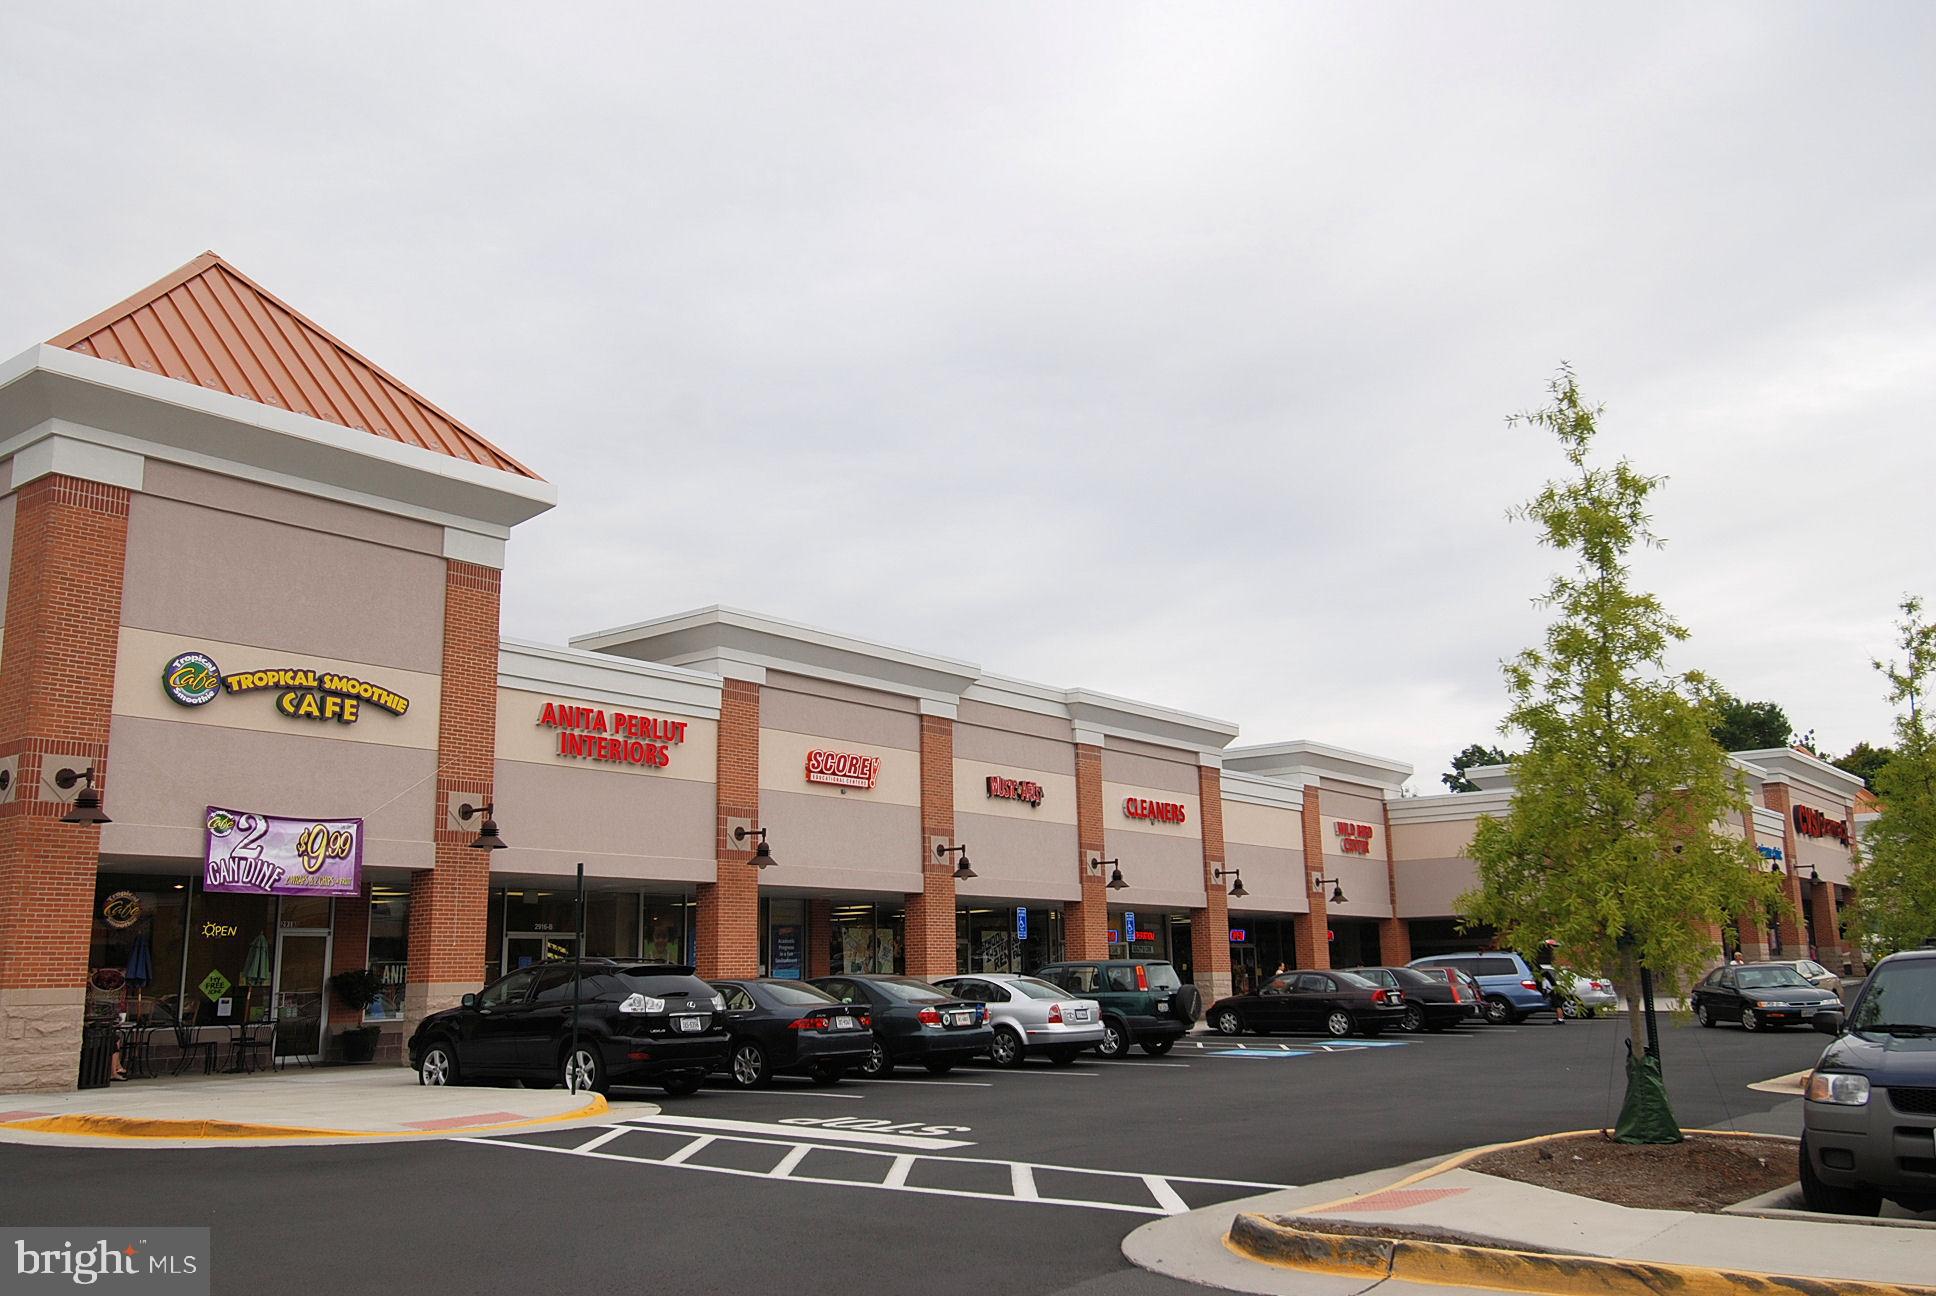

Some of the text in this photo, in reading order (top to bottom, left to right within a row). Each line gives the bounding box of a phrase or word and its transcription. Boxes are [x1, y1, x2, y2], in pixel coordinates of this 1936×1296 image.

[172, 654, 217, 672] Tropical
[227, 670, 408, 714] TROPICAL SMOOTHIE
[282, 692, 359, 721] CAFE
[540, 702, 688, 744] ANITA PERLUT
[561, 731, 669, 767] INTERIORS
[812, 773, 845, 783] EDUCATIONAL
[1126, 797, 1185, 823] CLEANERS
[230, 813, 268, 859] 2
[297, 823, 353, 872] $9.99
[209, 858, 284, 892] CAN DINE
[202, 922, 238, 938] OPEN
[778, 1117, 971, 1136] STOP
